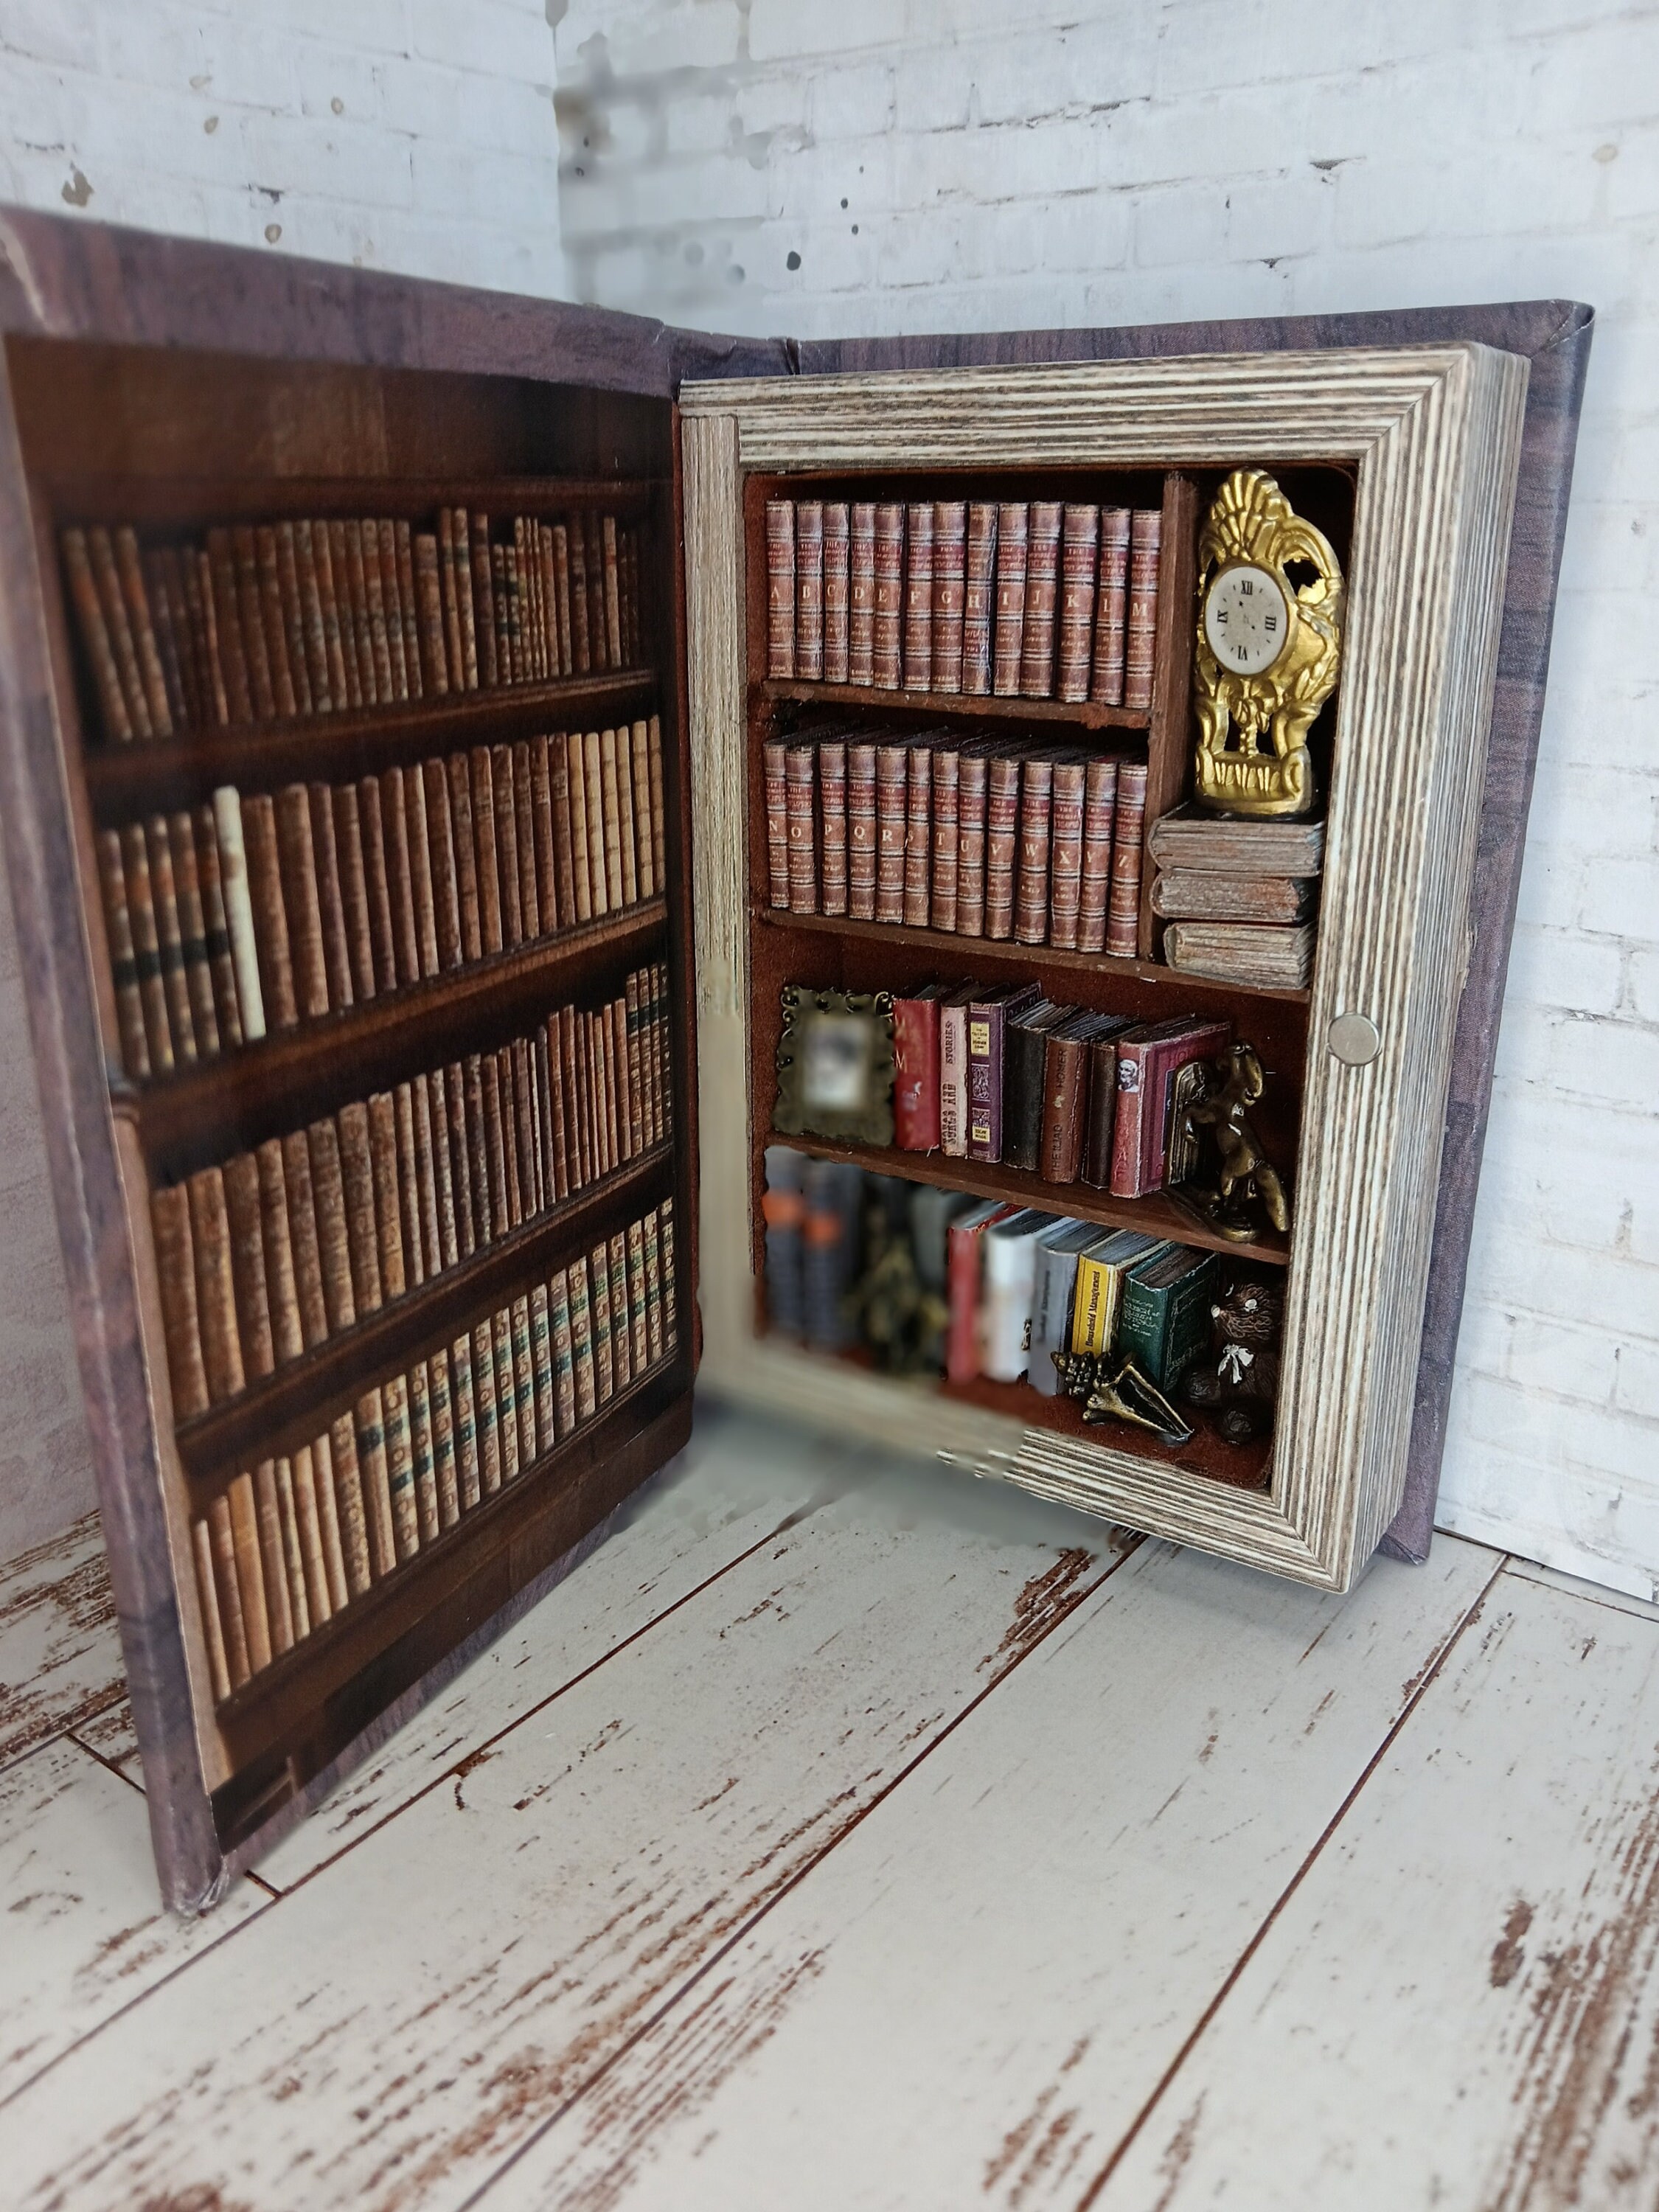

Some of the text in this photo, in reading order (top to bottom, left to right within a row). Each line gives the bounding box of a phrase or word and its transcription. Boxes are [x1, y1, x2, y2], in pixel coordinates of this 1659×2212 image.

[771, 586, 779, 599] A
[801, 585, 810, 599] B
[827, 584, 835, 597] C
[855, 586, 864, 599] D
[878, 588, 887, 602] E
[1241, 580, 1253, 596] XII
[910, 591, 920, 605] F
[941, 591, 952, 604] G
[968, 593, 980, 608] H
[1032, 591, 1040, 605] J
[1066, 594, 1079, 608] K
[1103, 598, 1110, 613] L
[1132, 602, 1147, 616] M
[1217, 610, 1228, 623] IX
[1265, 616, 1276, 631] III
[768, 820, 778, 832] N
[790, 826, 802, 838] O
[824, 824, 832, 836] P
[854, 825, 865, 840] Q
[882, 829, 893, 842] R
[936, 832, 945, 846] T
[960, 839, 970, 852] U
[991, 844, 1002, 855] V
[1025, 843, 1039, 857] W
[1059, 851, 1071, 865] X
[1087, 851, 1096, 863] Y
[1117, 855, 1129, 868] Z
[945, 1020, 954, 1065] STORIES
[1056, 1050, 1068, 1088] HOMER
[1051, 1124, 1062, 1172] THE ILIAD
[1088, 1271, 1101, 1312] Management
